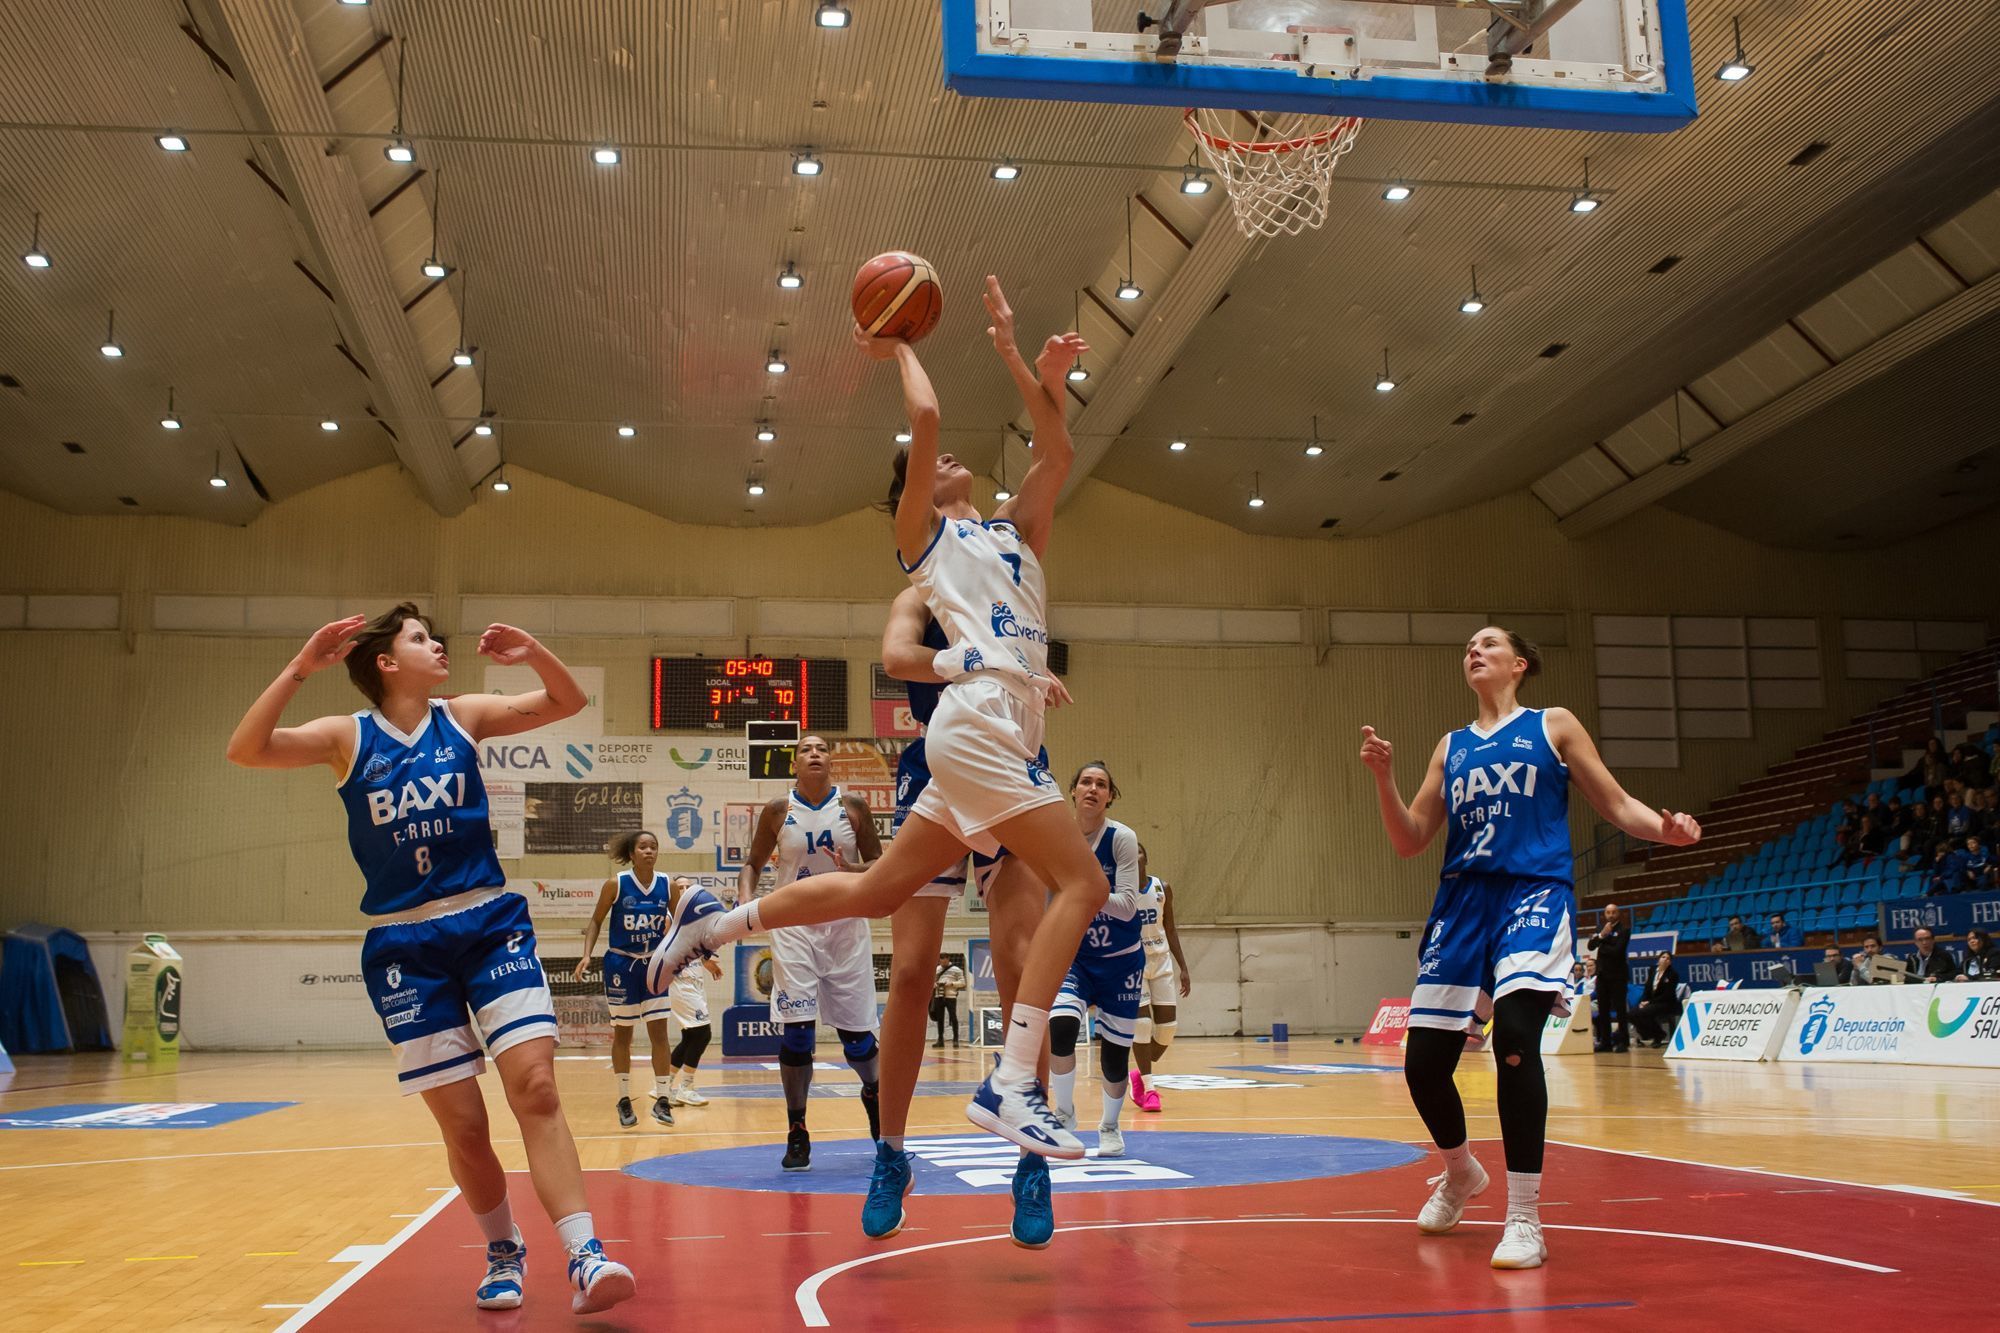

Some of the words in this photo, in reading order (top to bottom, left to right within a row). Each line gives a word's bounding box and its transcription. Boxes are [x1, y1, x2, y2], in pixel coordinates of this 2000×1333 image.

[998, 552, 1022, 587] 7
[726, 660, 773, 676] 05:40
[711, 689, 732, 704] 31
[745, 686, 754, 696] 4
[773, 690, 794, 705] 70
[598, 744, 653, 754] DEPORTE
[598, 754, 648, 764] GALEGO
[763, 745, 796, 777] 17
[1450, 761, 1538, 814] BAXI
[366, 773, 466, 827] BAXI
[573, 786, 642, 813] Golden
[805, 829, 835, 855] 14
[414, 846, 434, 876] 8
[541, 888, 594, 900] hyliacom
[623, 913, 665, 931] BAXI
[1087, 925, 1113, 948] 32
[381, 988, 418, 1003] Deputación
[1389, 1006, 1411, 1017] GRUPO
[1713, 1001, 1782, 1015] FUNDACIÓN
[1706, 1019, 1761, 1032] DEPORTE
[1834, 1016, 1906, 1036] Deputación
[1700, 1035, 1748, 1048] GALEGO
[1825, 1037, 1844, 1050] DA
[1846, 1034, 1899, 1051] CORUÑA
